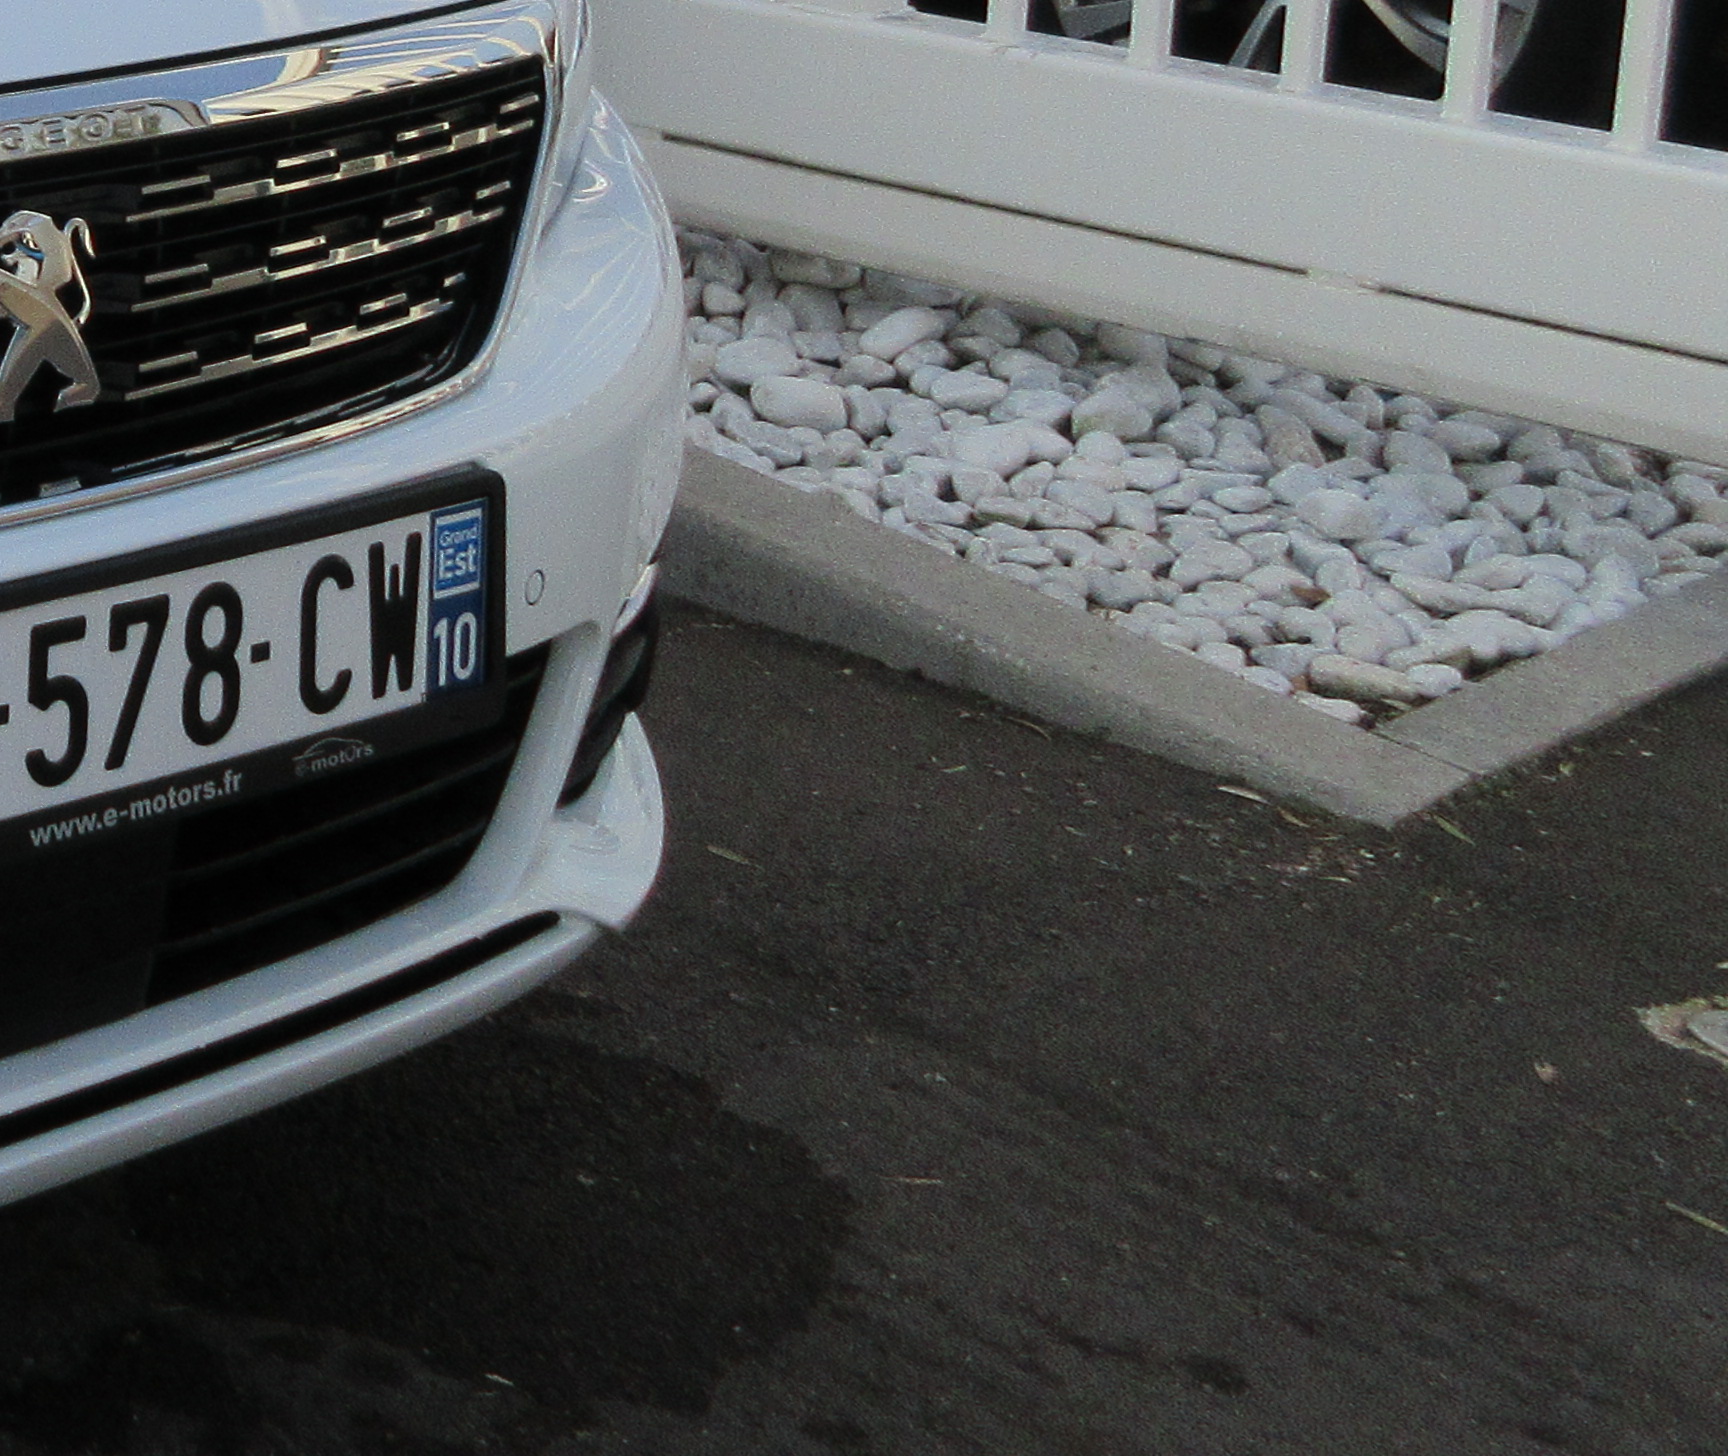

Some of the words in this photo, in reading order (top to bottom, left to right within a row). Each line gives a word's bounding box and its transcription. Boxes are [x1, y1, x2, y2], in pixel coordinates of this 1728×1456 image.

[438, 544, 477, 580] Est
[439, 526, 479, 547] Grand
[433, 611, 478, 687] 10
[29, 767, 244, 847] www.e-motors.fr
